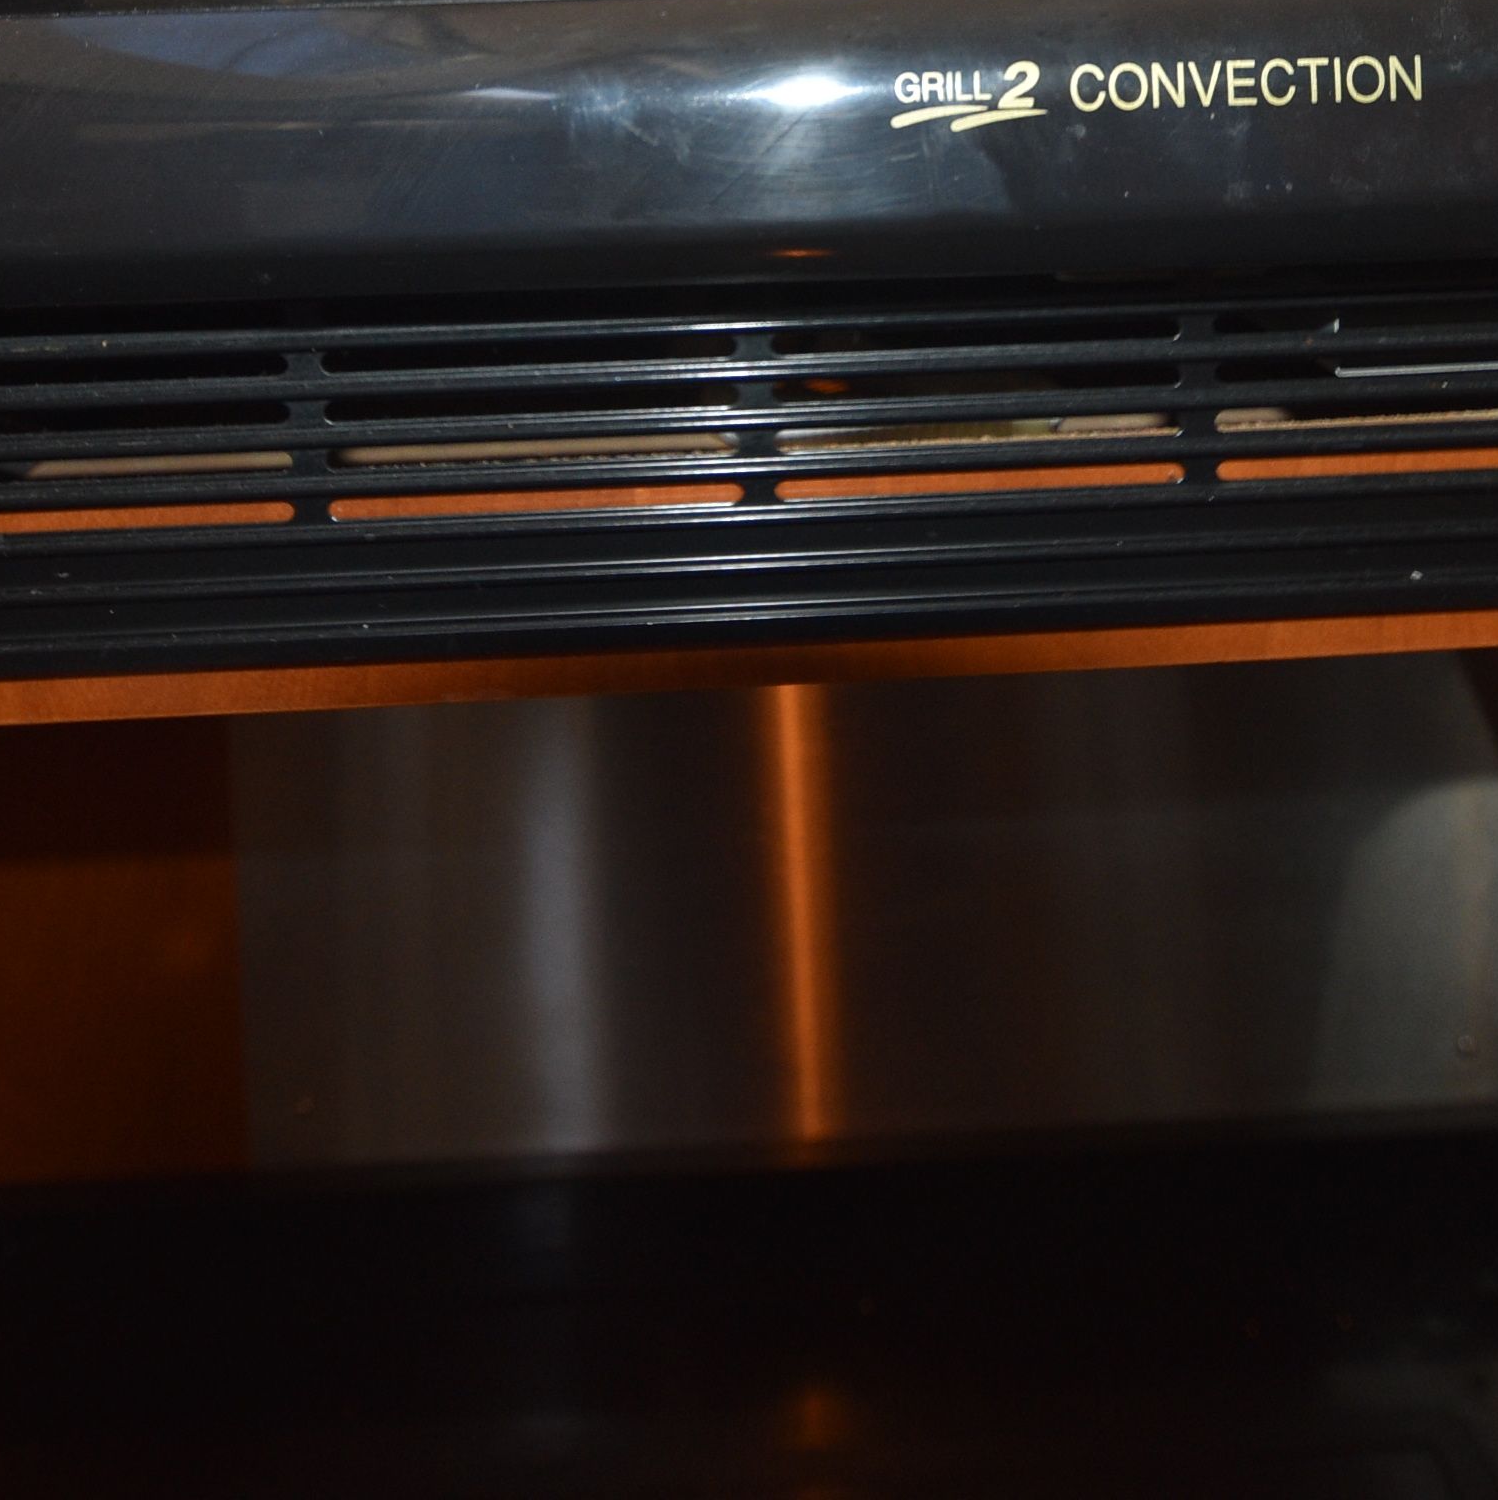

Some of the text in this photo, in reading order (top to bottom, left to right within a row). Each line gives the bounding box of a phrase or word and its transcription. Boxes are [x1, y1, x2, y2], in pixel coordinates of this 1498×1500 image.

[893, 54, 1423, 113] GRILL 2 CONVECTION
